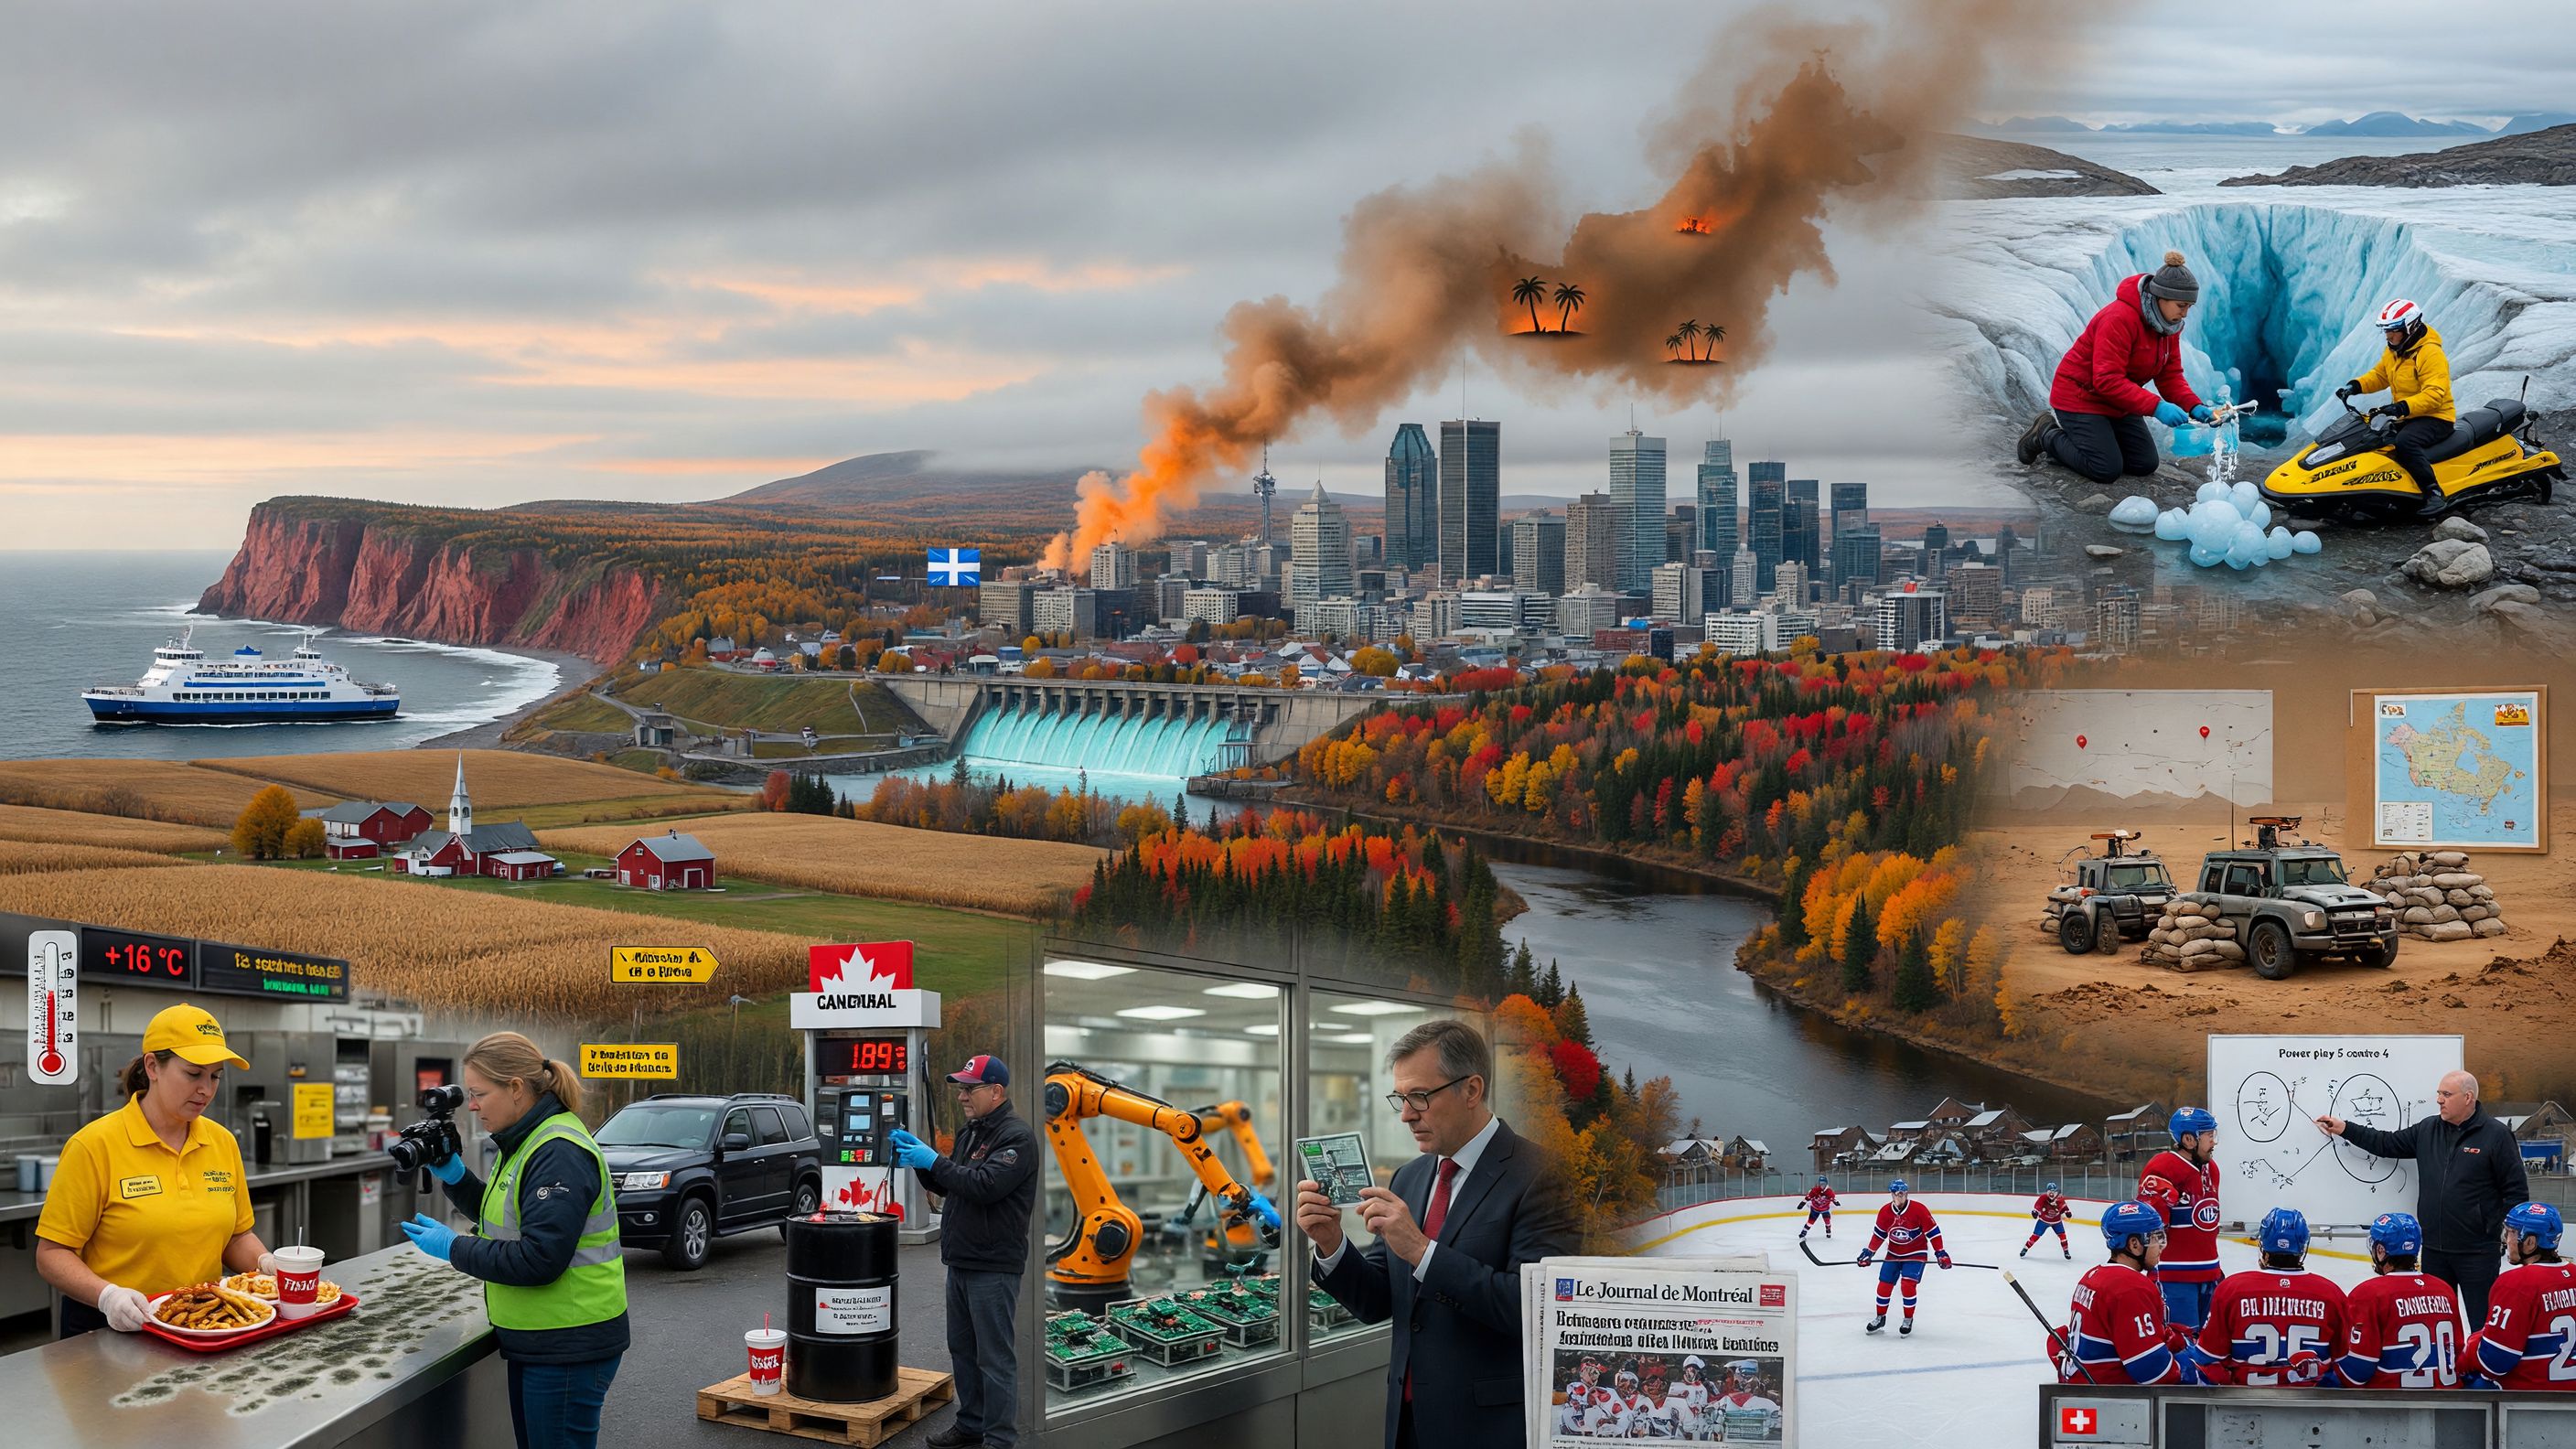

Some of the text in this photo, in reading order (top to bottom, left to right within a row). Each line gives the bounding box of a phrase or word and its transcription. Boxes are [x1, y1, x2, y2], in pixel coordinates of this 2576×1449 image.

[105, 944, 183, 976] +16 °C
[2279, 1048, 2311, 1058] Power
[2313, 1048, 2334, 1060] play
[2337, 1047, 2344, 1058] 5
[2382, 1048, 2389, 1058] 4
[1576, 1281, 1594, 1297] Le
[1597, 1282, 1658, 1300] Journal
[1661, 1284, 1680, 1301] de
[1681, 1285, 1754, 1304] Montréal
[2488, 1305, 2512, 1330] 31
[2398, 1320, 2457, 1388] 20
